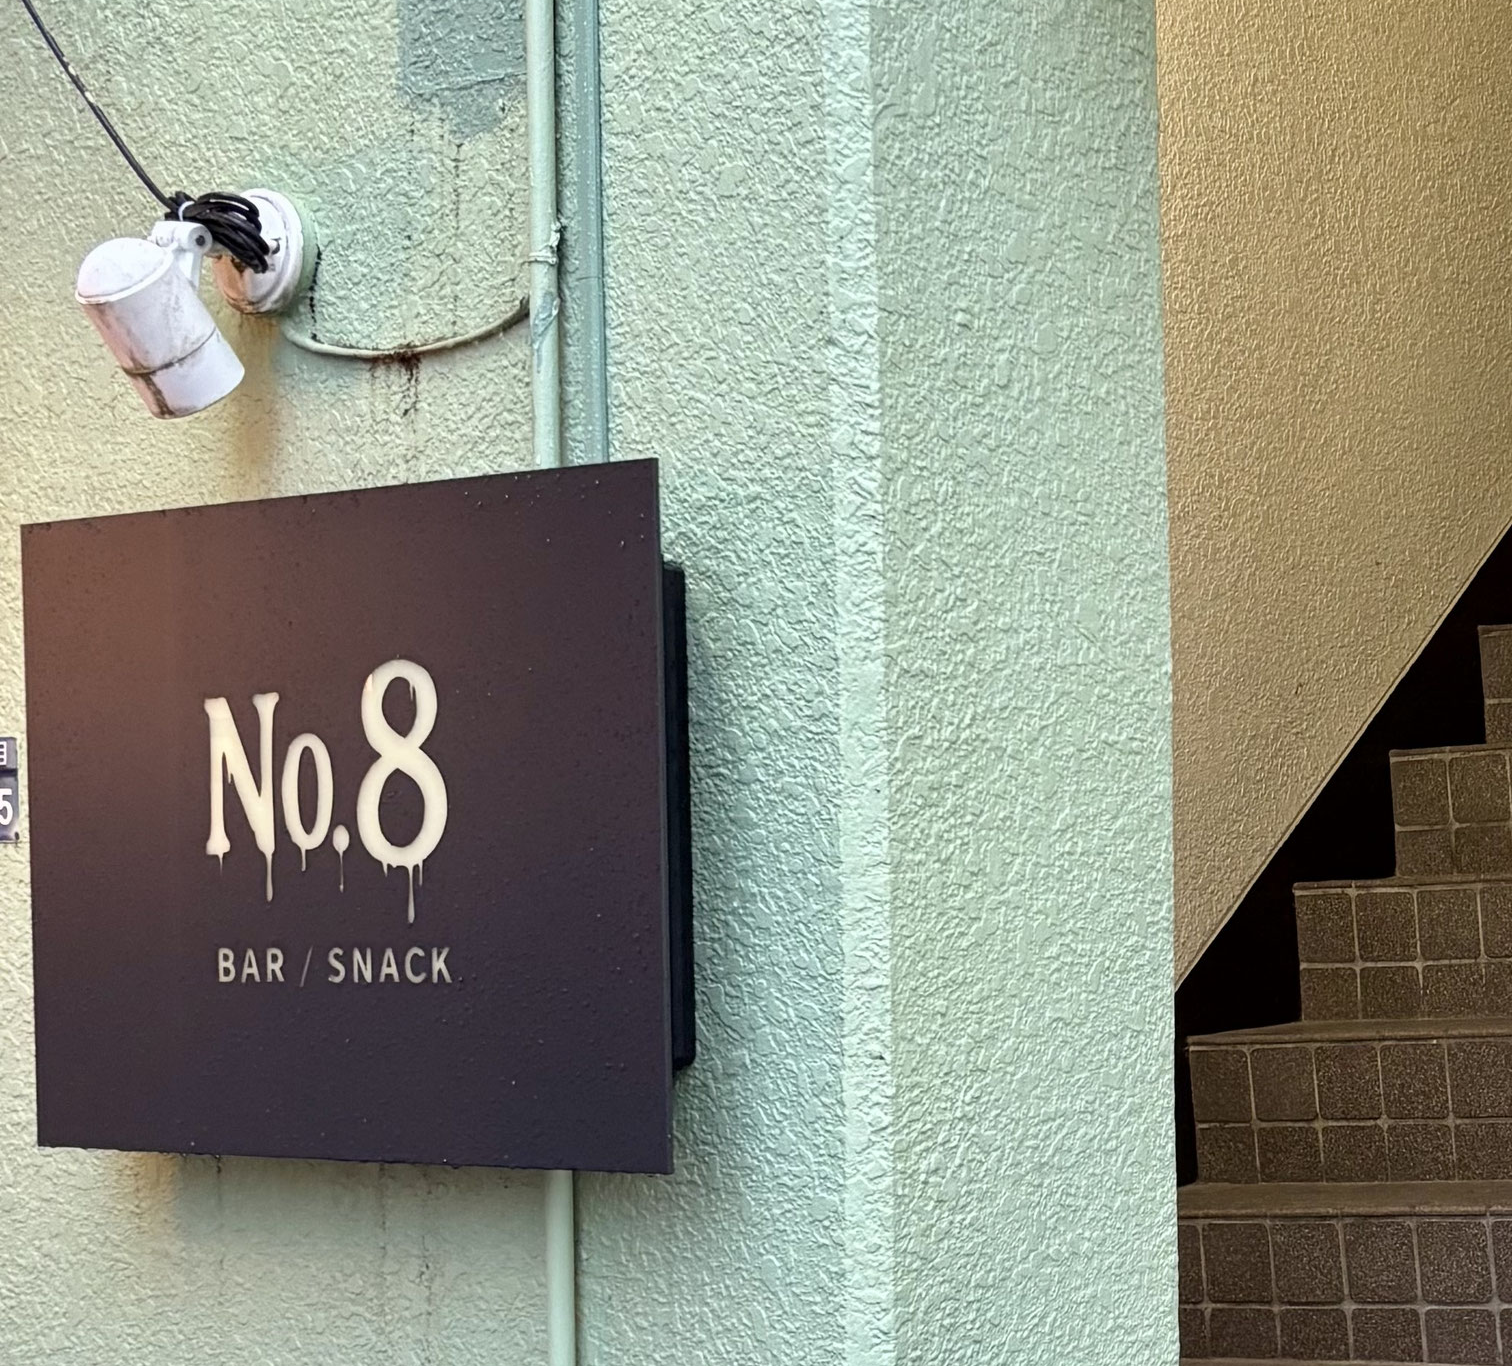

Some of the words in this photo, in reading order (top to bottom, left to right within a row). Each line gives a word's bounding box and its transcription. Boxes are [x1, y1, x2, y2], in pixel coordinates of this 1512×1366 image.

[203, 658, 449, 924] No.8
[217, 948, 286, 984] BAR
[328, 946, 453, 984] SNACK
